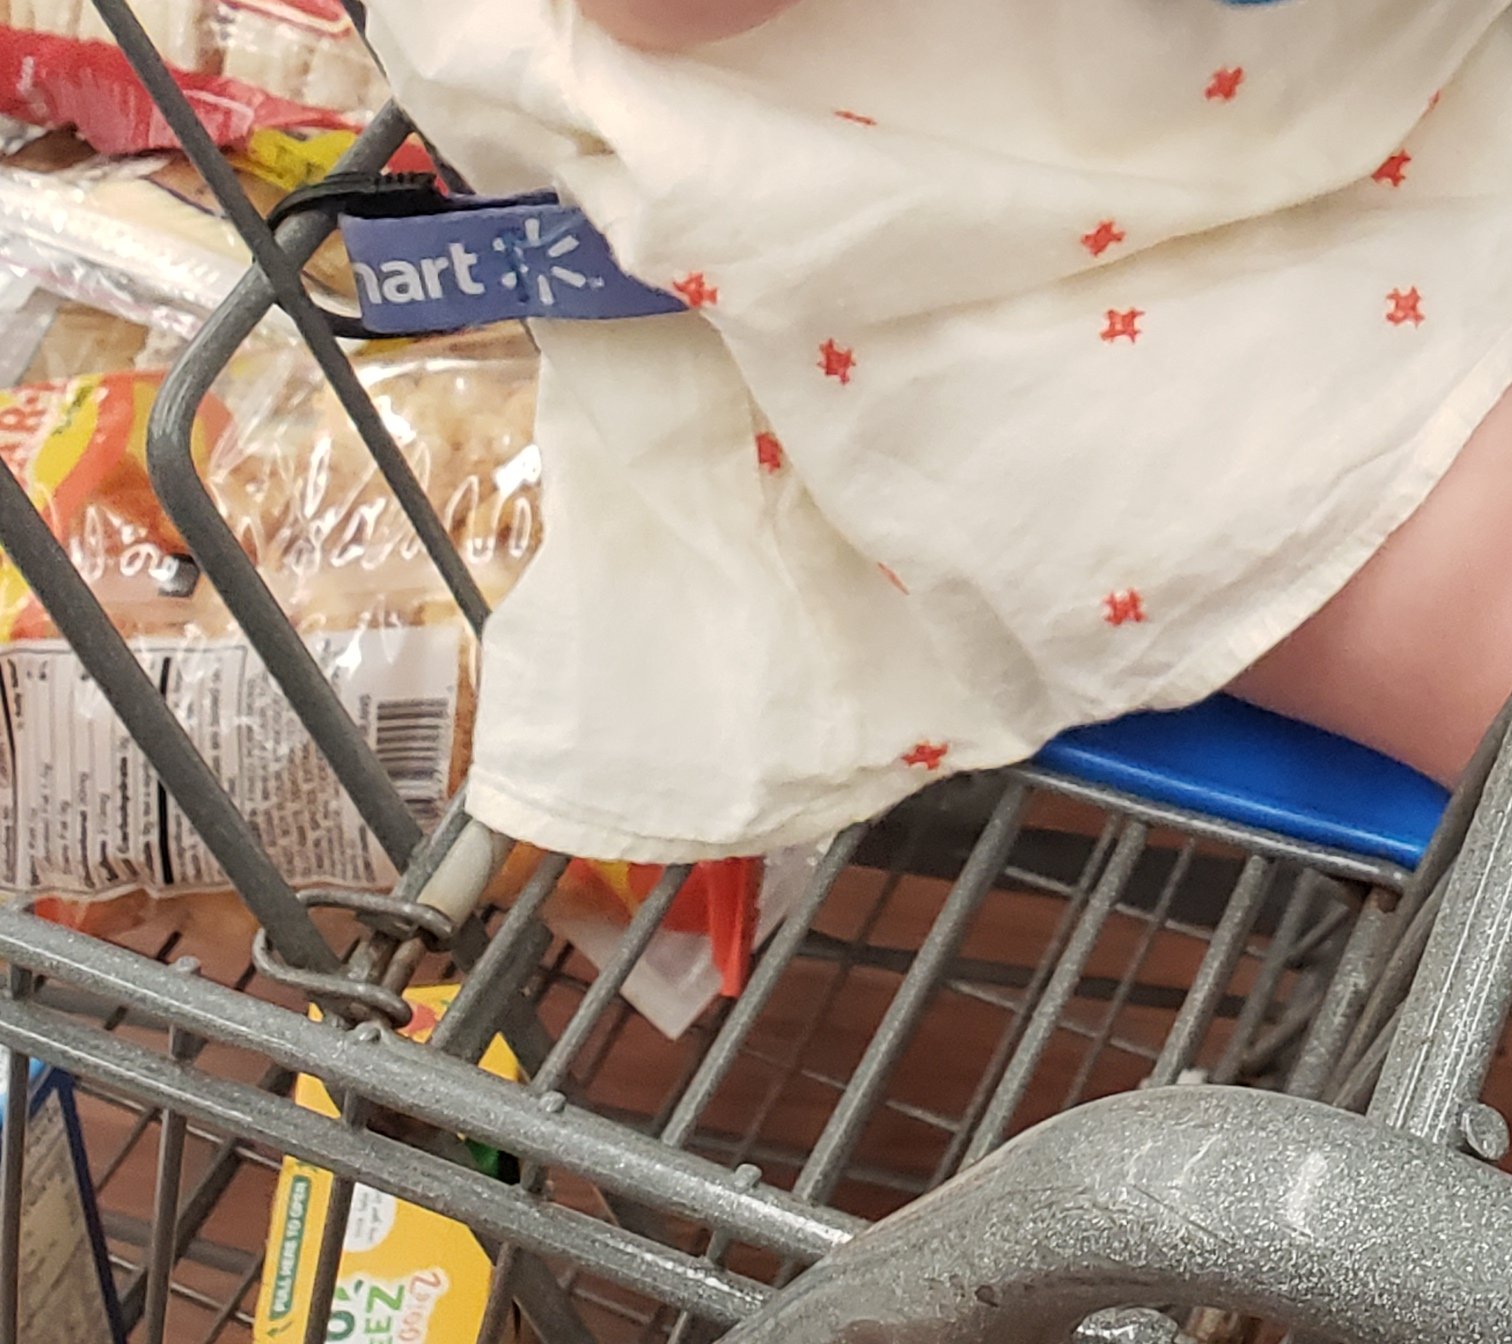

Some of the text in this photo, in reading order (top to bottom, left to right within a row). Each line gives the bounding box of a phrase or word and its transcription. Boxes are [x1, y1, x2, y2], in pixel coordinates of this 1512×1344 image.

[271, 1180, 308, 1312] PULL HERE TO OPEN
